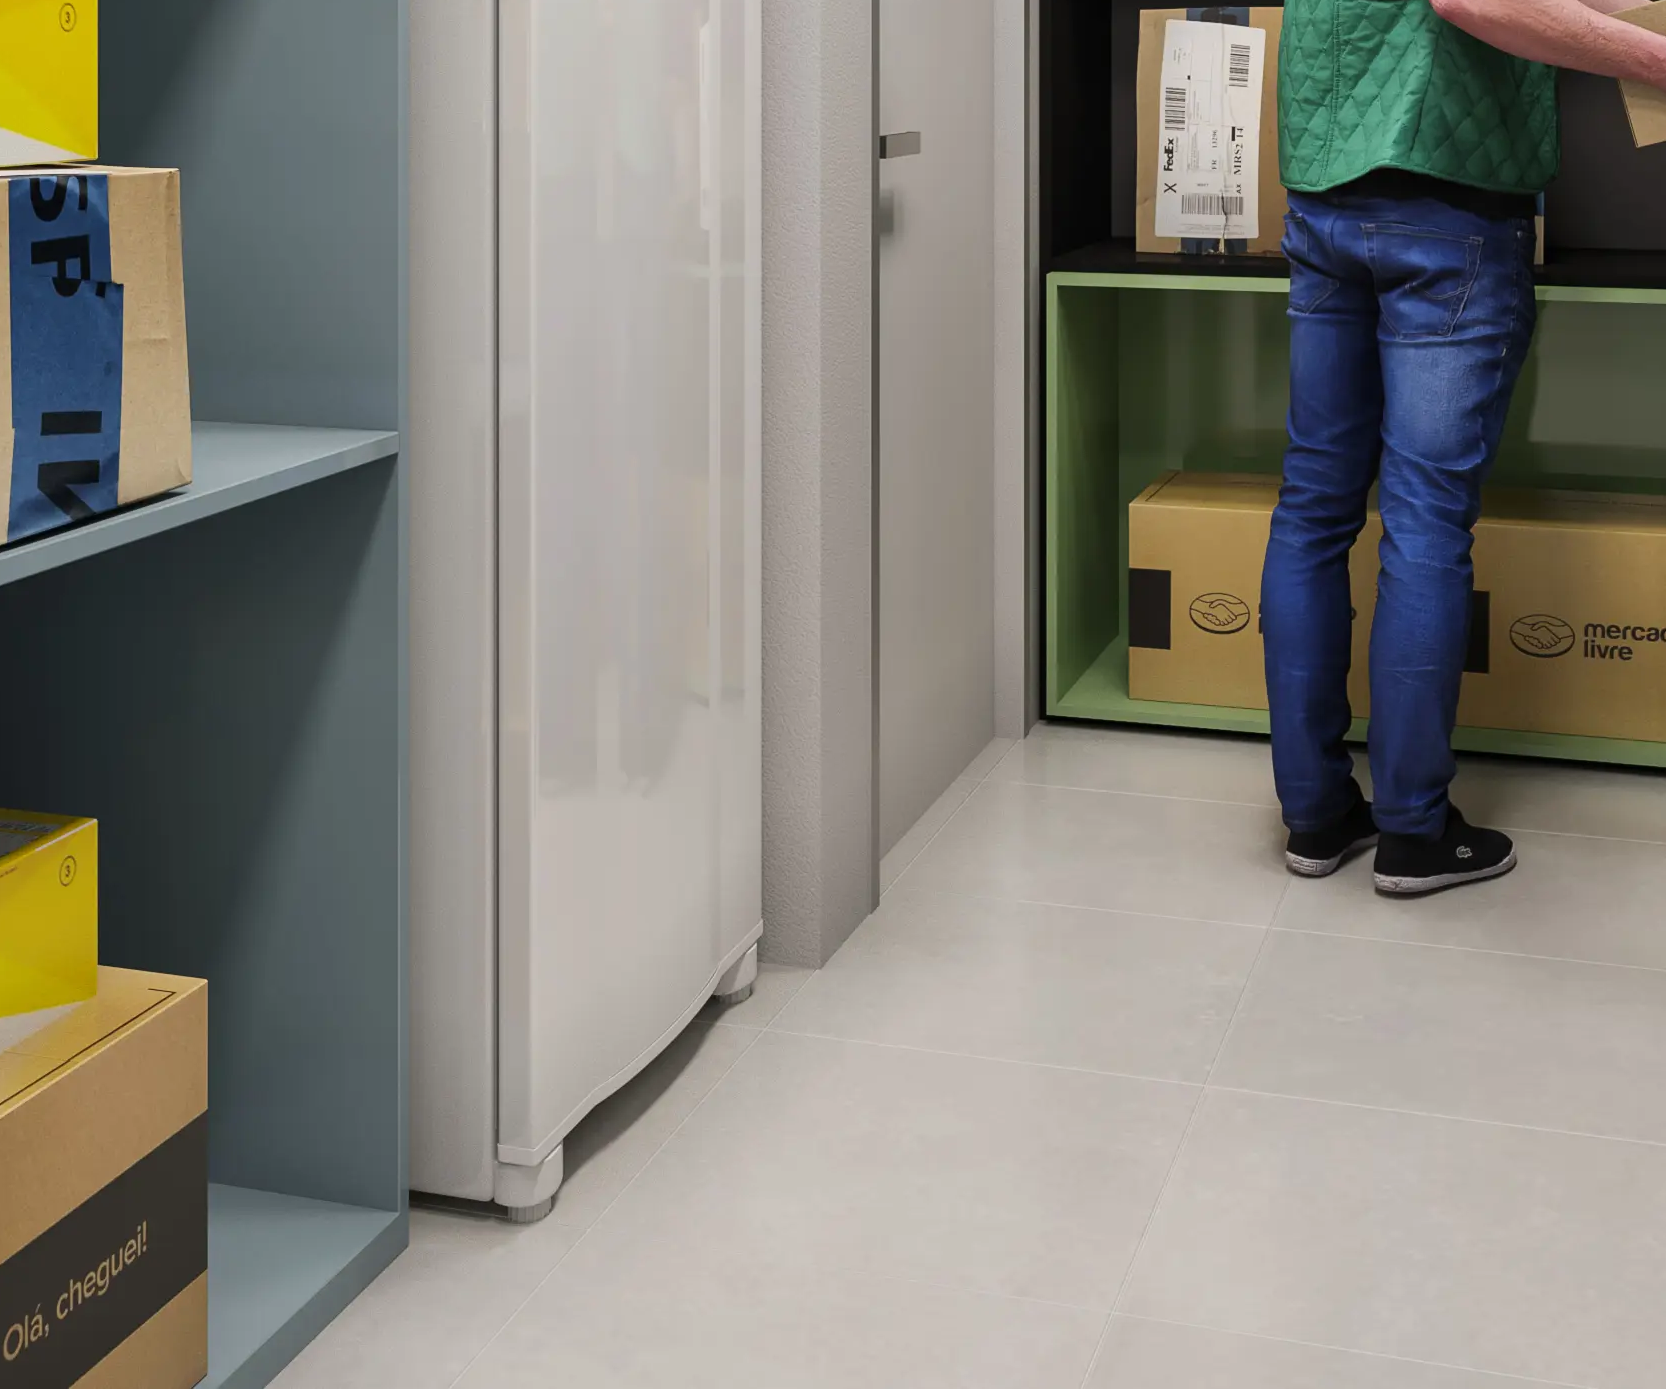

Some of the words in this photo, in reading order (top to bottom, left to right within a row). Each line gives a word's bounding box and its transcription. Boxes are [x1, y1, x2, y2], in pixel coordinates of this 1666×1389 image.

[1236, 127, 1244, 139] 14
[1163, 137, 1175, 172] FedEx
[1233, 143, 1244, 176] MRS2
[1163, 182, 1177, 194] X
[1583, 639, 1633, 661] livre
[2, 1302, 50, 1362] Olá,
[55, 1219, 148, 1320] cheguei!
